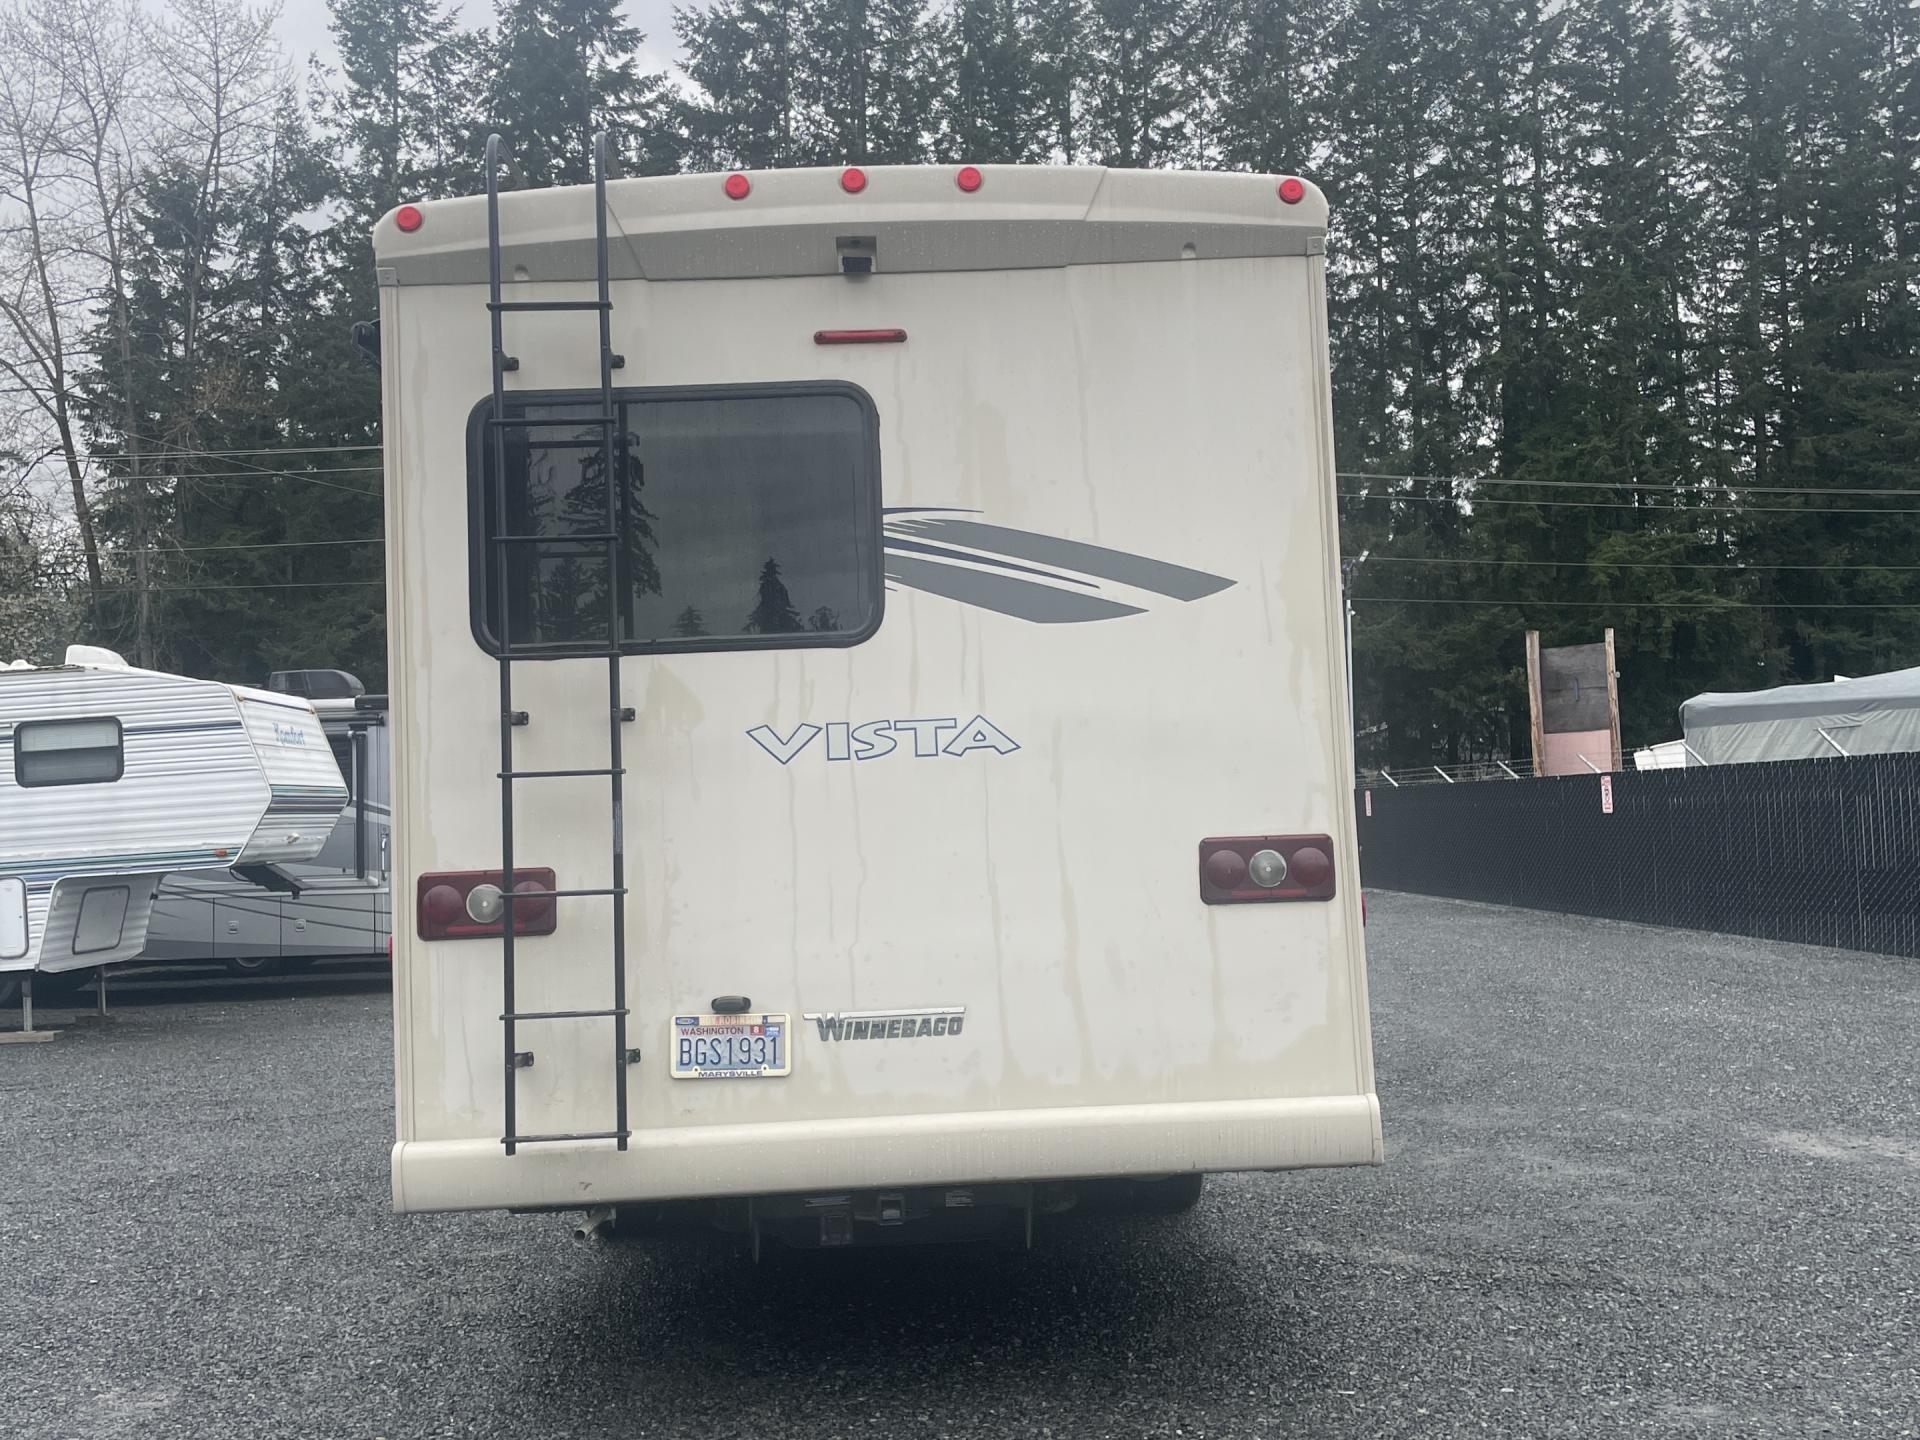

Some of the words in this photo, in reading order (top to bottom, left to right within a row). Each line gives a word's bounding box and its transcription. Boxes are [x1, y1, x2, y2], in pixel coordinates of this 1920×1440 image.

[745, 714, 1022, 765] VISTA
[680, 1026, 744, 1036] WASHINGTON
[815, 1012, 965, 1042] WINNEBAGO
[679, 1036, 777, 1066] BGS1931
[698, 1070, 763, 1078] MARYSVILLE
